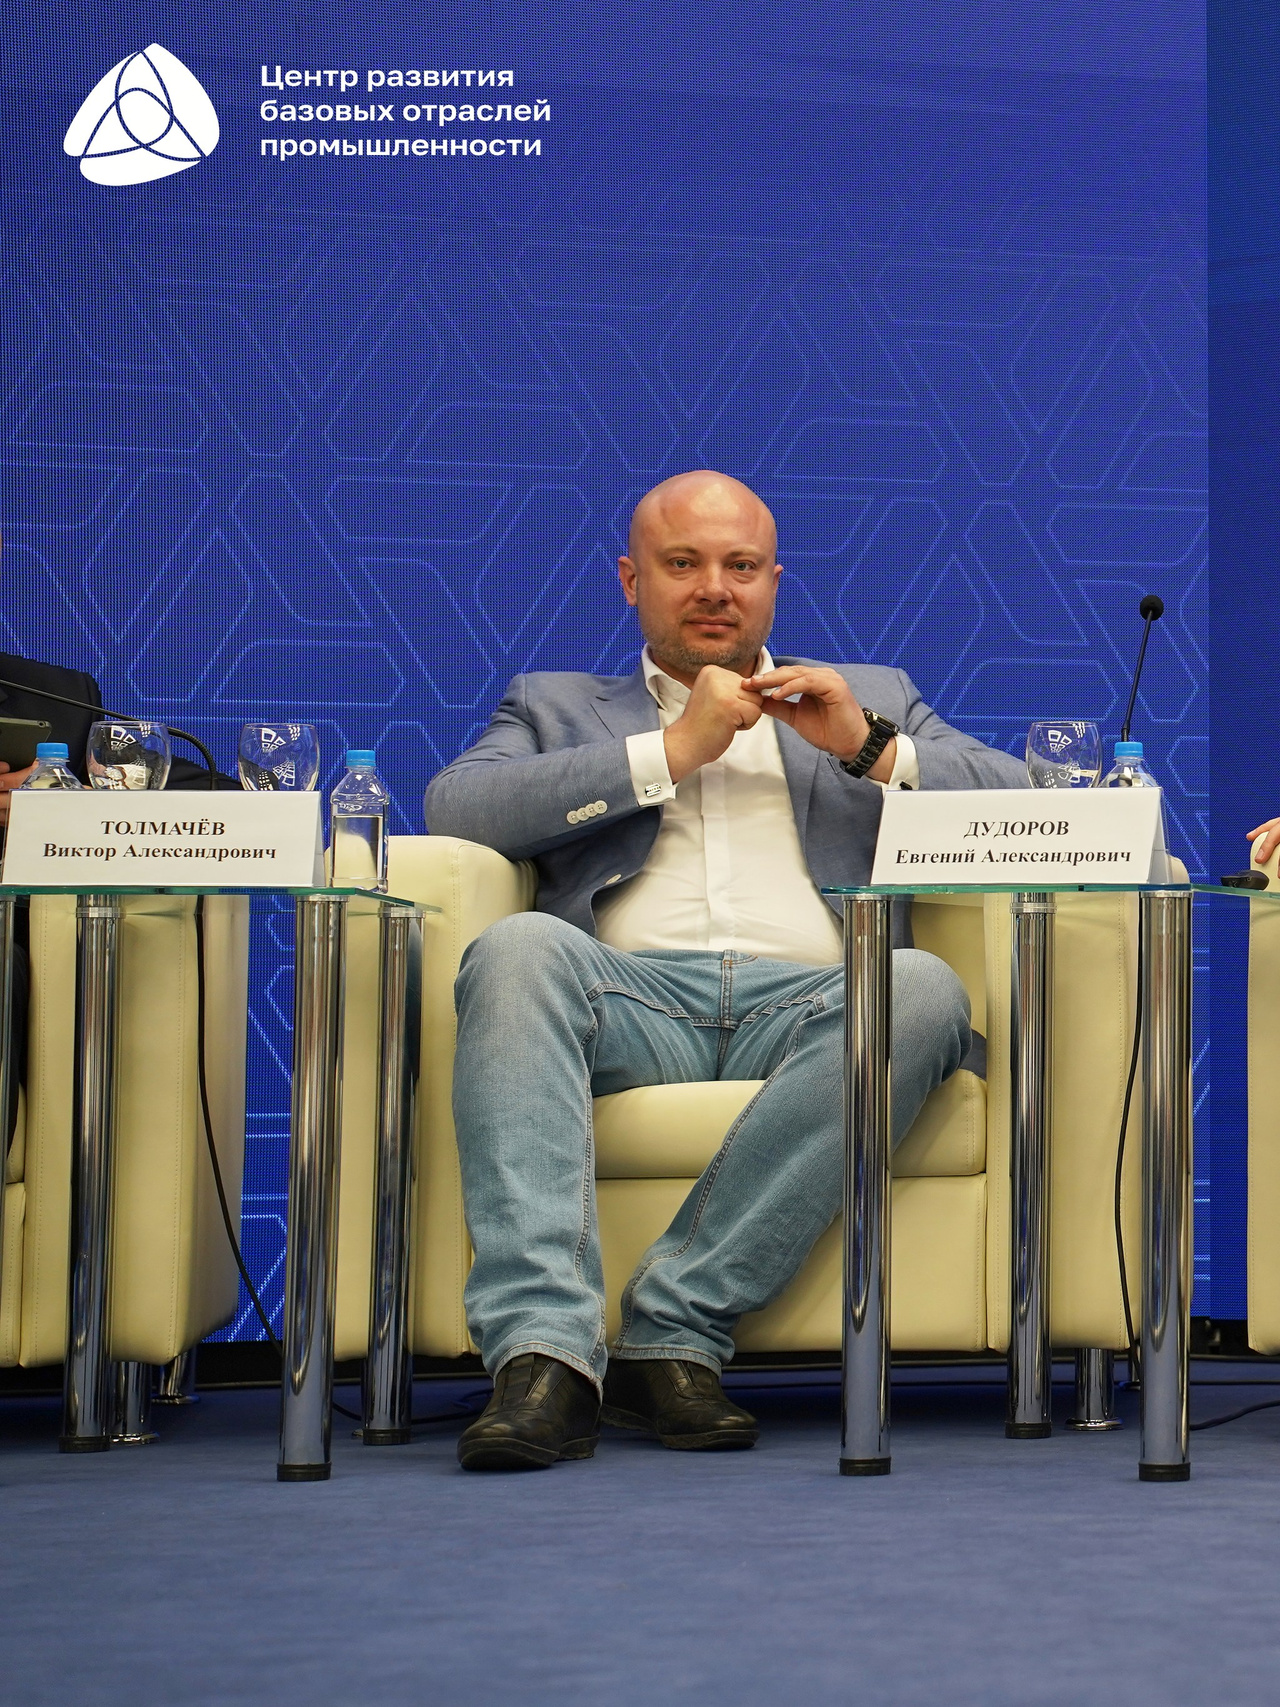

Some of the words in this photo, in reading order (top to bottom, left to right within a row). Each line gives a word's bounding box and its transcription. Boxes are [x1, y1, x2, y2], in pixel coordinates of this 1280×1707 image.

[100, 818, 226, 836] ТОЛМАЧЁВ
[963, 820, 1070, 839] ДУДОРОВ
[43, 843, 117, 862] Виктор
[122, 844, 277, 862] Александрович
[895, 848, 976, 865] Евгений
[981, 849, 1132, 867] Александрович
